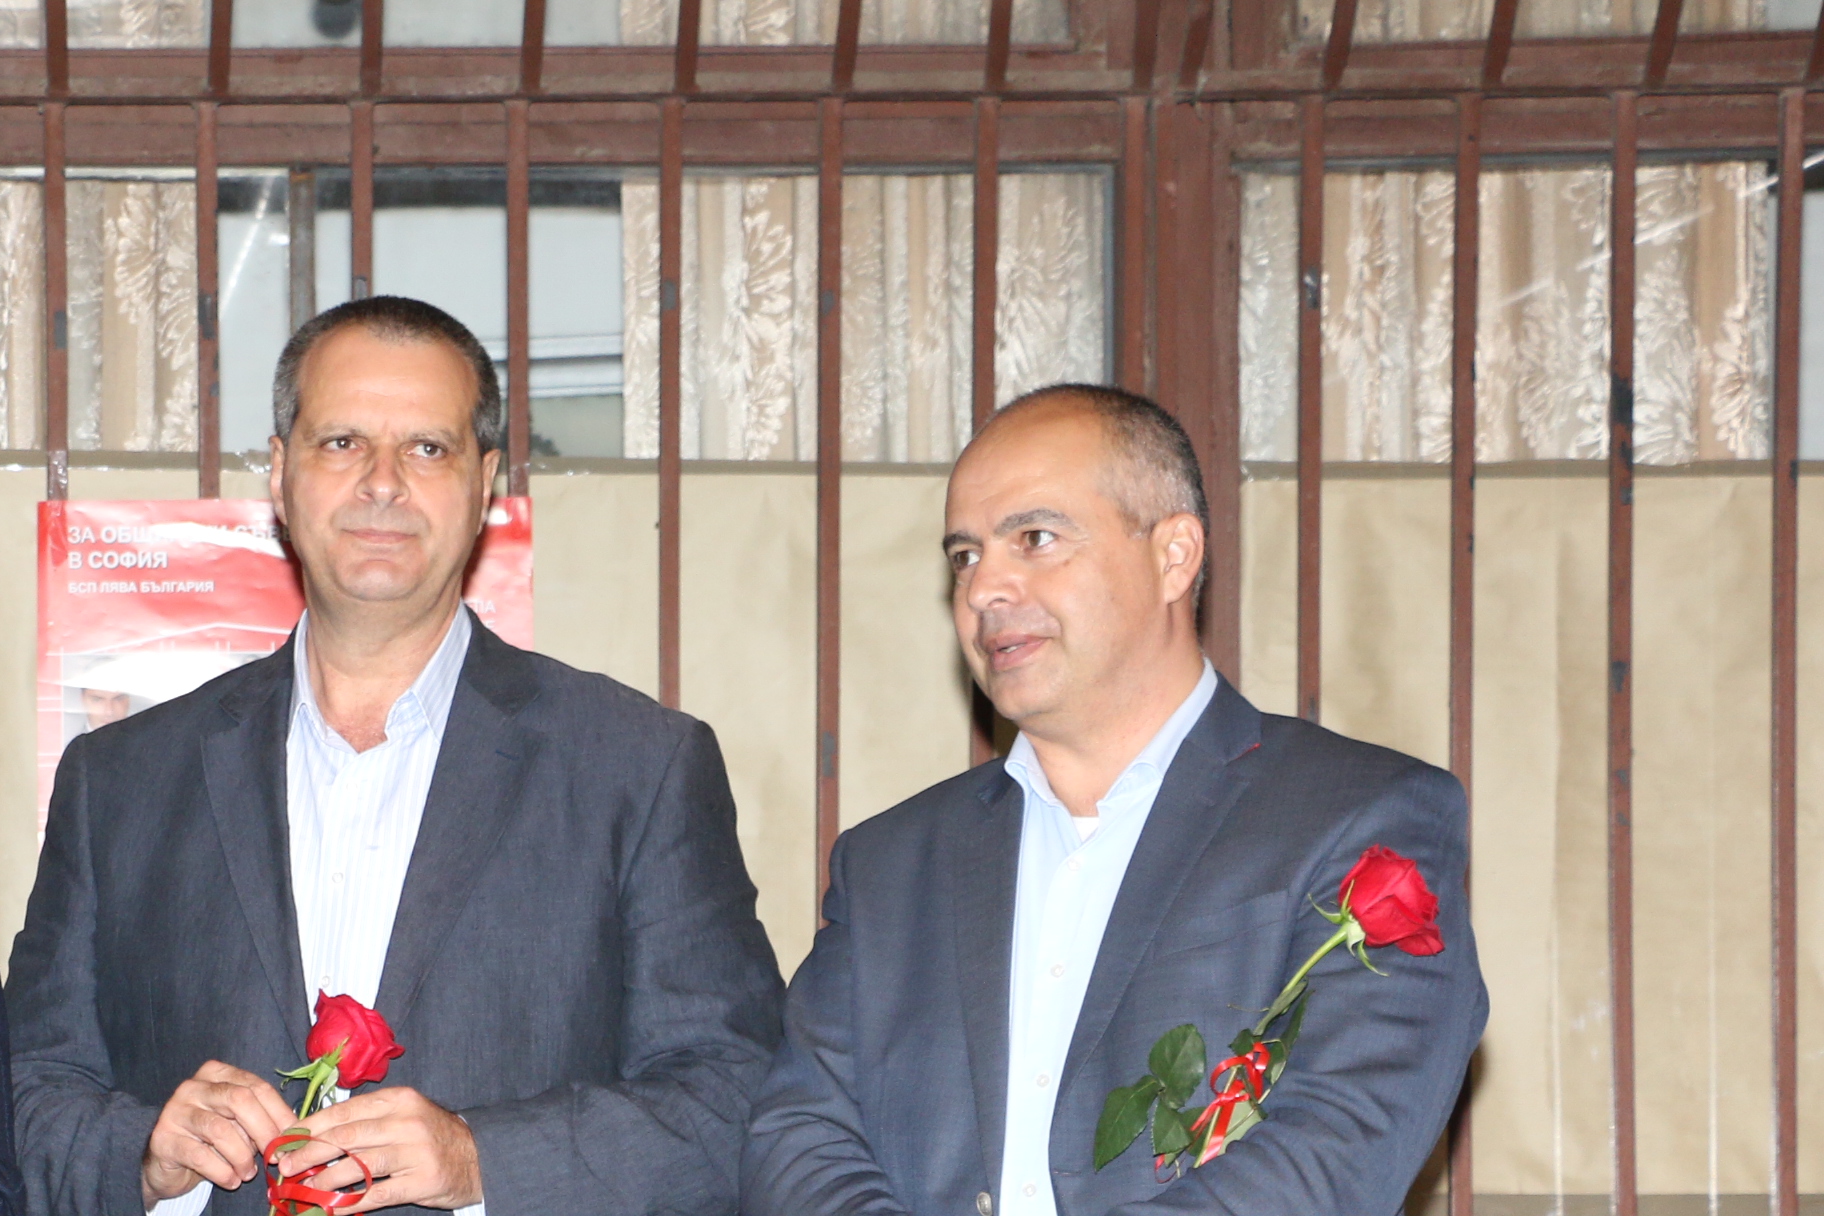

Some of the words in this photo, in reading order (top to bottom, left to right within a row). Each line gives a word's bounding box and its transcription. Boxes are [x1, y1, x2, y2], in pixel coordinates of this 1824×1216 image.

[68, 527, 95, 544] ЗА
[68, 552, 82, 569] В
[88, 551, 168, 569] СОФИЯ
[68, 582, 97, 593] БСП
[100, 582, 137, 593] ЛЯВА
[140, 581, 214, 593] БЪЛГАРИЯ
